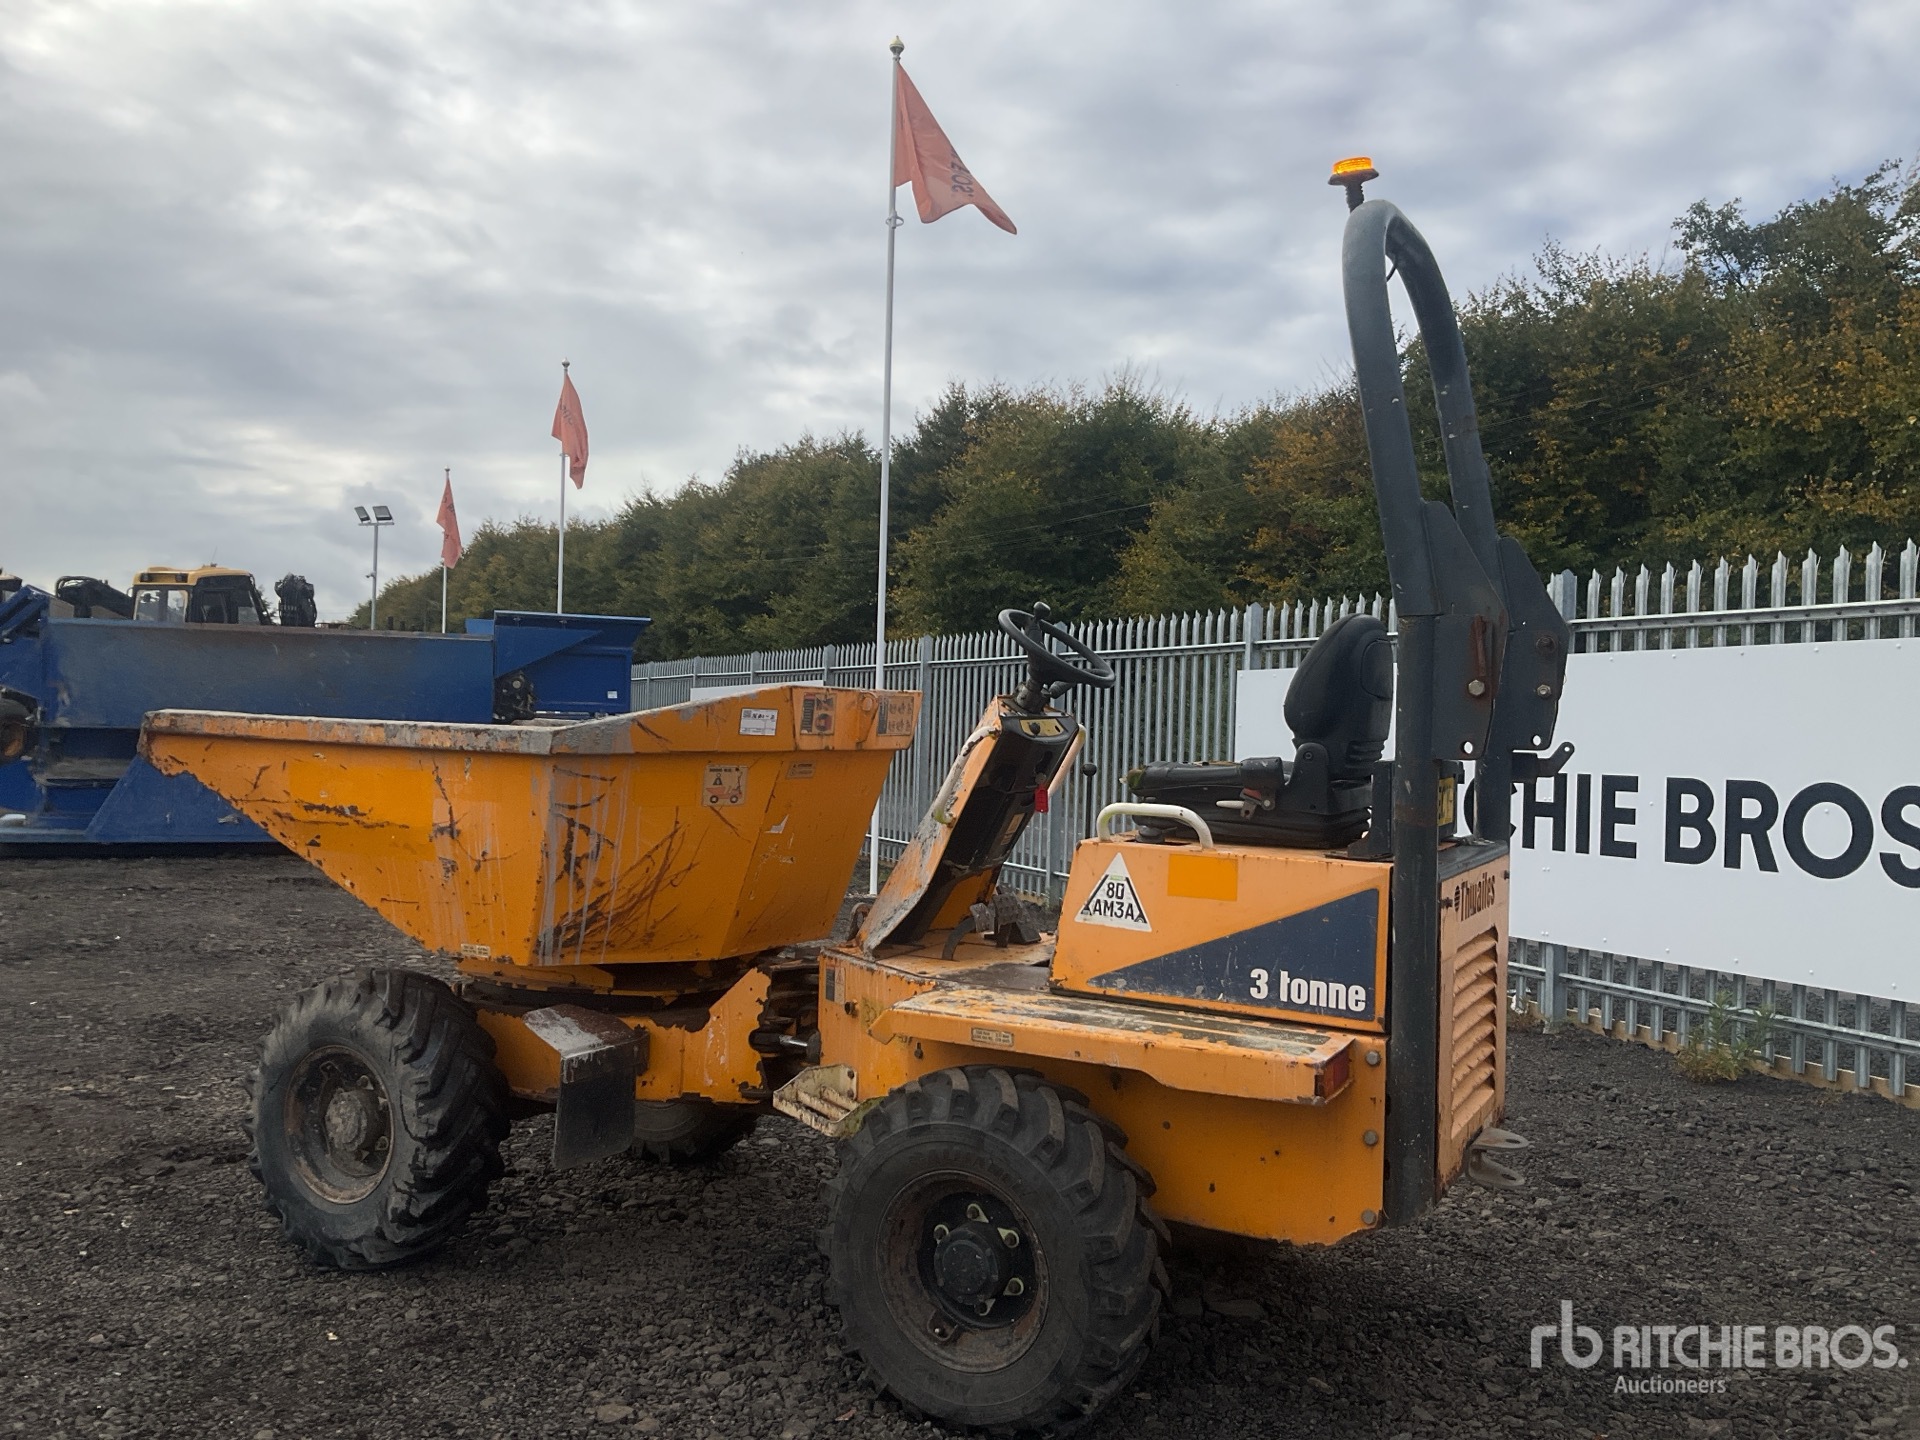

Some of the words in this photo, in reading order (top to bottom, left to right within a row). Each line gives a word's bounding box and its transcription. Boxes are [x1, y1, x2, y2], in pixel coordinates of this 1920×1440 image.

[1664, 777, 1920, 889] BROS
[1249, 967, 1269, 1000] 3
[1279, 969, 1367, 1012] tonne
